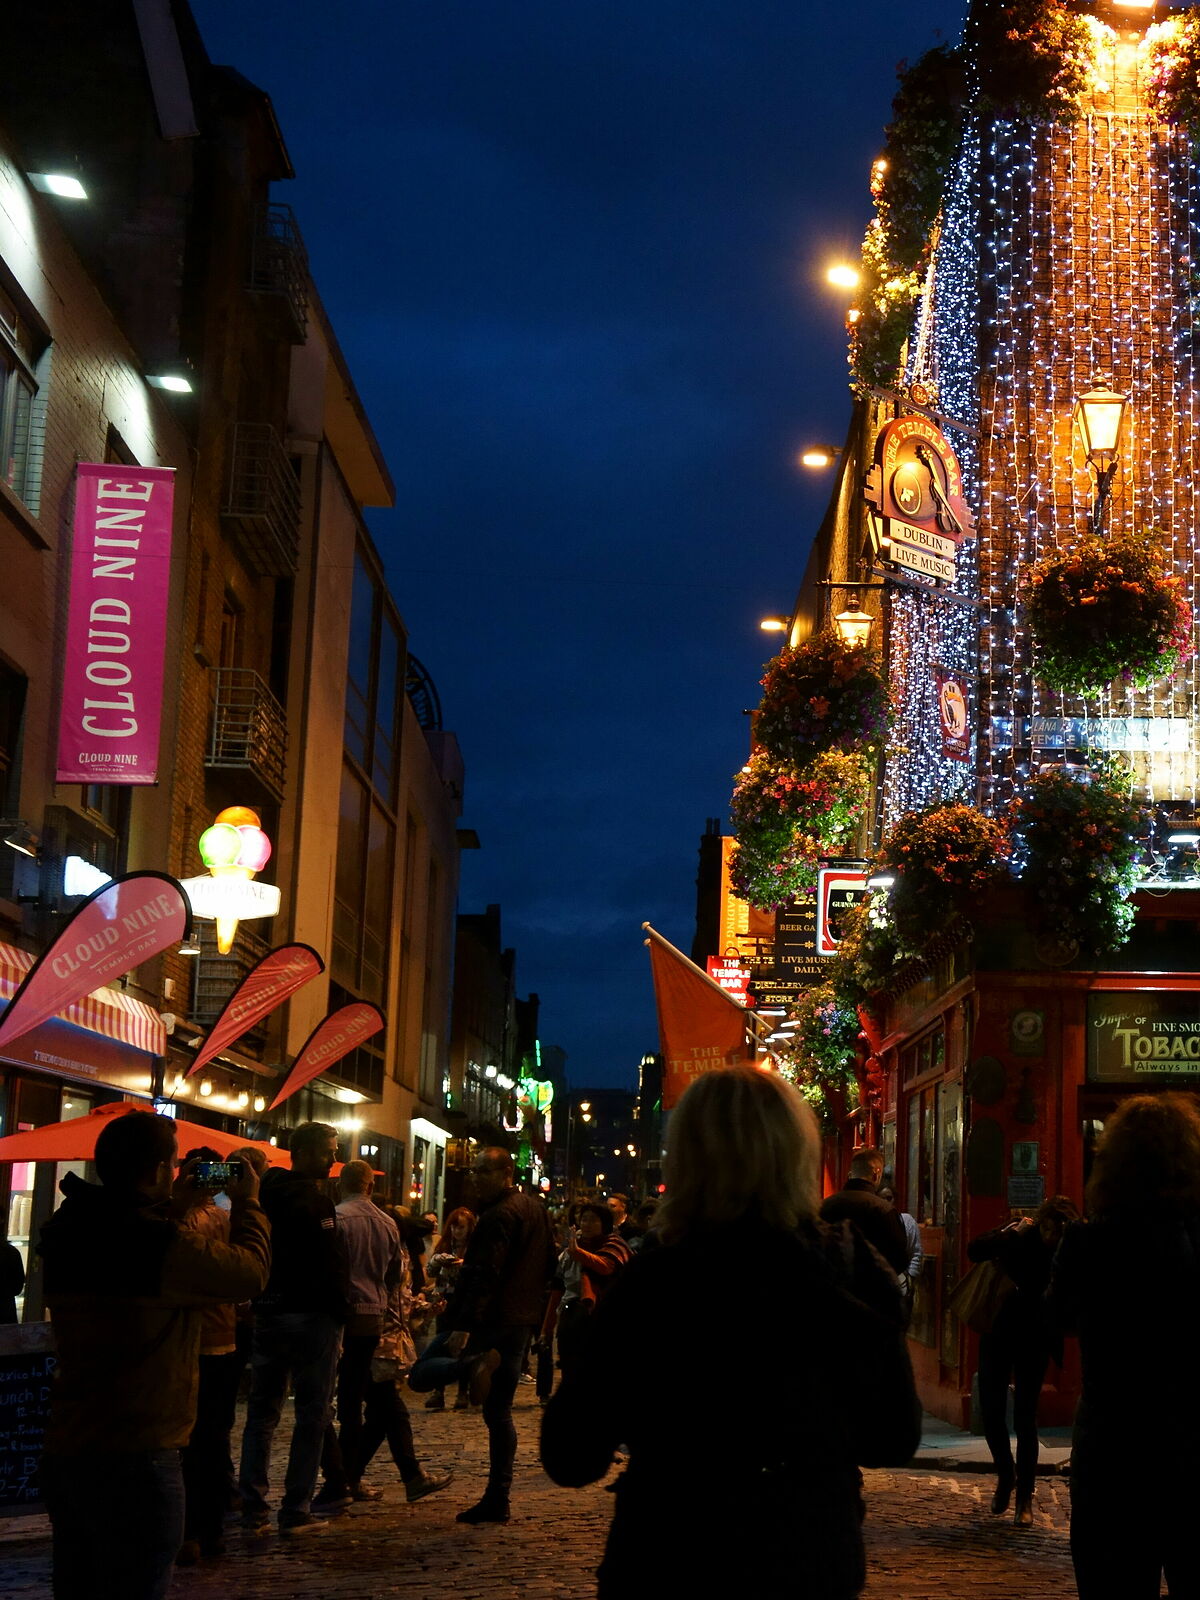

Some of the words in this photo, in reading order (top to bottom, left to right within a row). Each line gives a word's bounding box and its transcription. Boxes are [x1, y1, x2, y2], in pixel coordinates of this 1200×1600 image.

[885, 434, 900, 470] THE
[899, 421, 947, 455] TEMPLE
[945, 455, 960, 498] BAR
[92, 478, 155, 581] NINE
[904, 528, 943, 551] DUBLIN
[896, 547, 918, 566] LIVE
[921, 557, 952, 577] MUSIC
[81, 597, 139, 738] CLOUD
[1031, 734, 1076, 745] TEMPE
[79, 752, 111, 764] CLOUD
[114, 753, 138, 766] NINE
[780, 924, 802, 932] BEER
[52, 926, 120, 980] CLOUD
[122, 893, 176, 934] NINE
[97, 950, 136, 975] TEMPLE
[138, 937, 158, 951] BAR
[744, 956, 762, 964] THE
[782, 956, 808, 964] LIVE
[712, 968, 751, 978] TEMPLE
[794, 966, 823, 974] DAILY
[719, 979, 742, 988] BAR
[229, 983, 277, 1022] CLOUD
[765, 995, 794, 1003] STORE
[1134, 1017, 1148, 1025] OF
[1152, 1022, 1178, 1033] FINE
[306, 1032, 346, 1066] CLOUD
[344, 1008, 374, 1035] NINE
[690, 1046, 721, 1058] THE
[1135, 1061, 1181, 1073] Always
[1186, 1061, 1199, 1072] in
